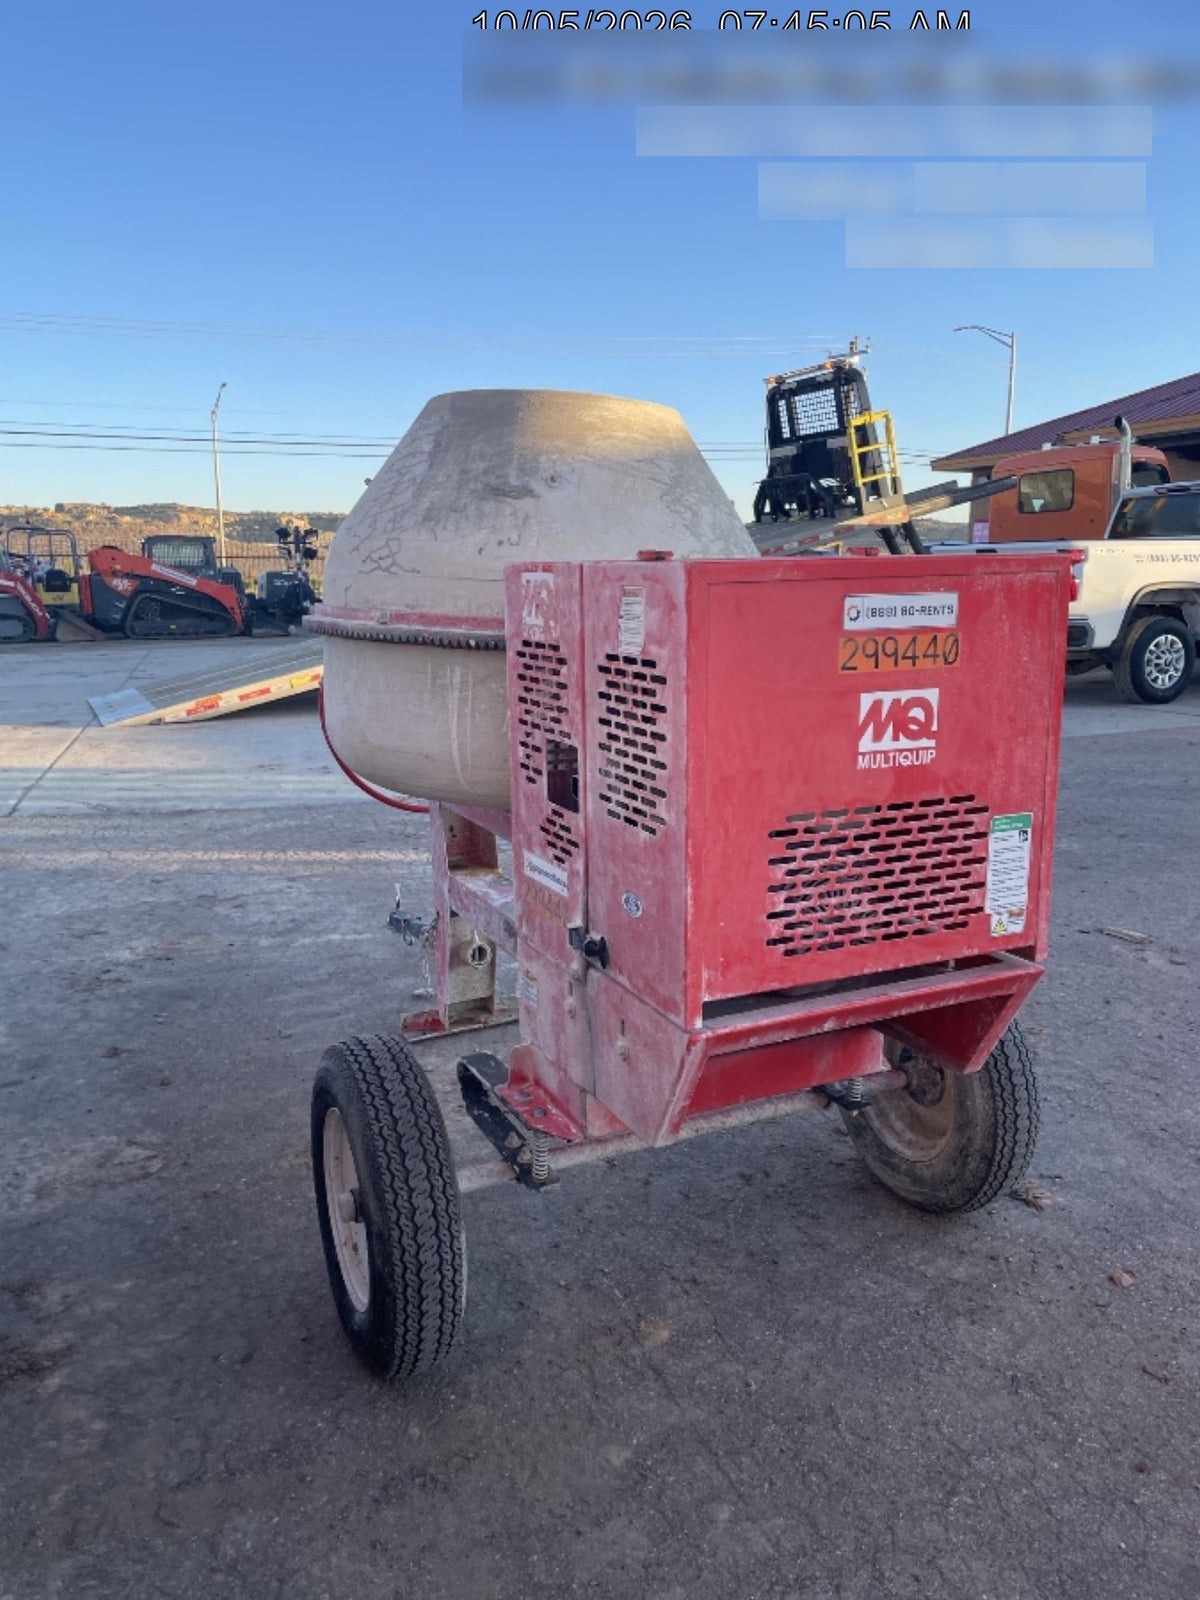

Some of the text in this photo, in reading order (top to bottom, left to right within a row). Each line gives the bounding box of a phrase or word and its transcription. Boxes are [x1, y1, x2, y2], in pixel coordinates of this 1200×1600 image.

[840, 632, 960, 671] 299440
[858, 693, 938, 745] MQ
[857, 750, 936, 770] MULTIQUIP
